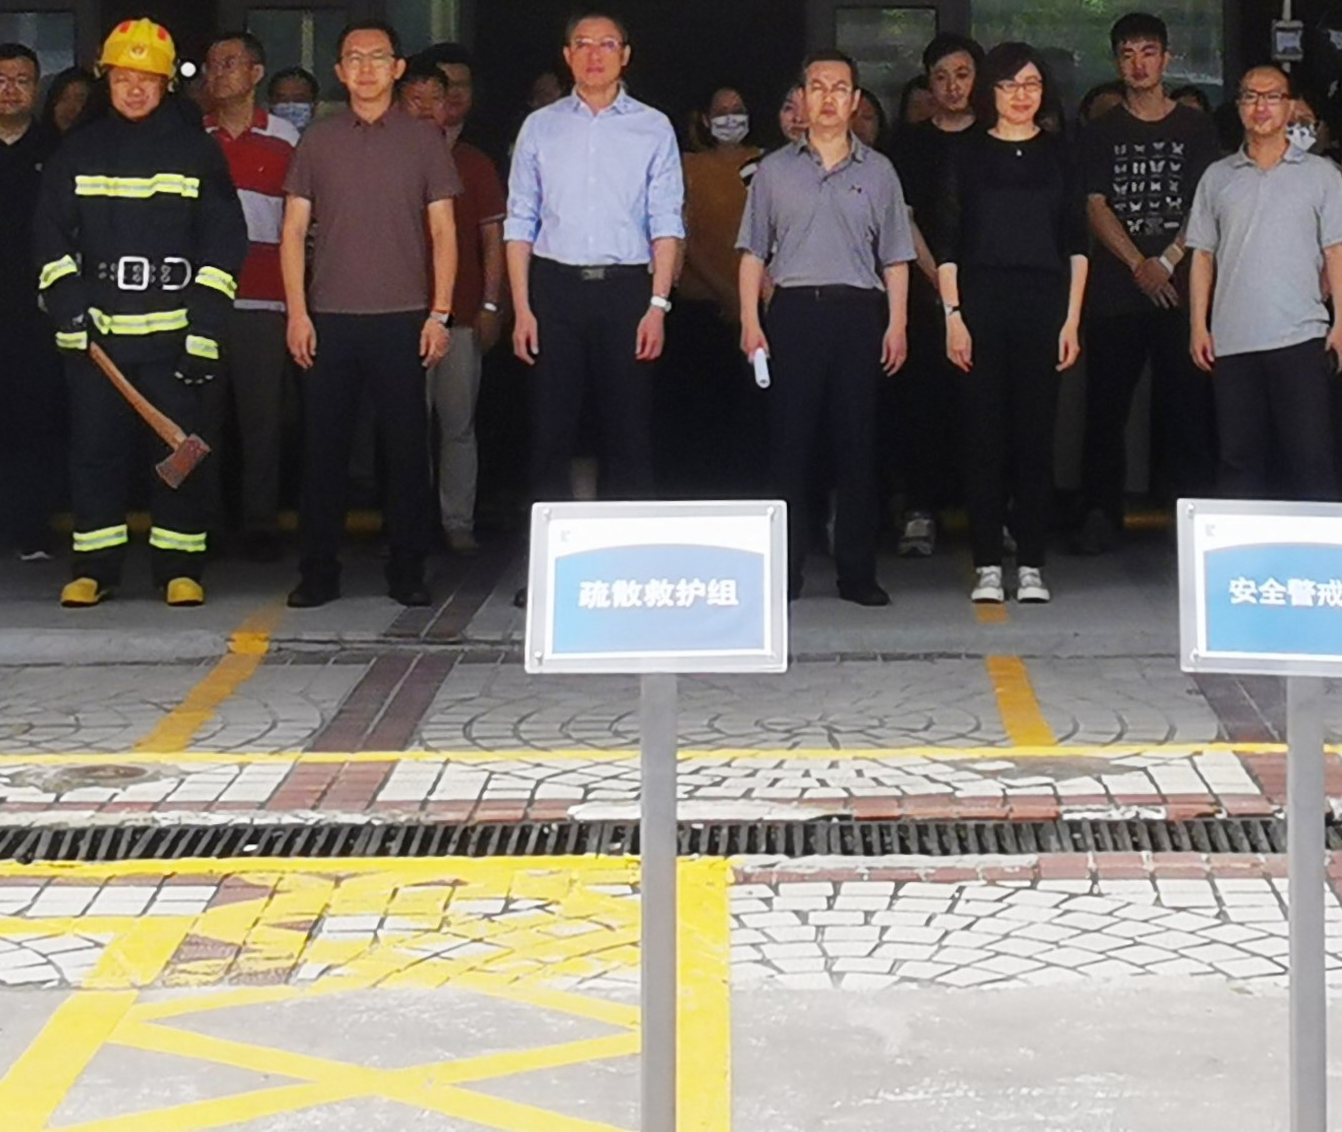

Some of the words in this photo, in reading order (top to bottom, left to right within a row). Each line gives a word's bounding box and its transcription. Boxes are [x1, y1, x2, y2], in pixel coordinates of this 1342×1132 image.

[578, 578, 739, 609] 疏散救护组
